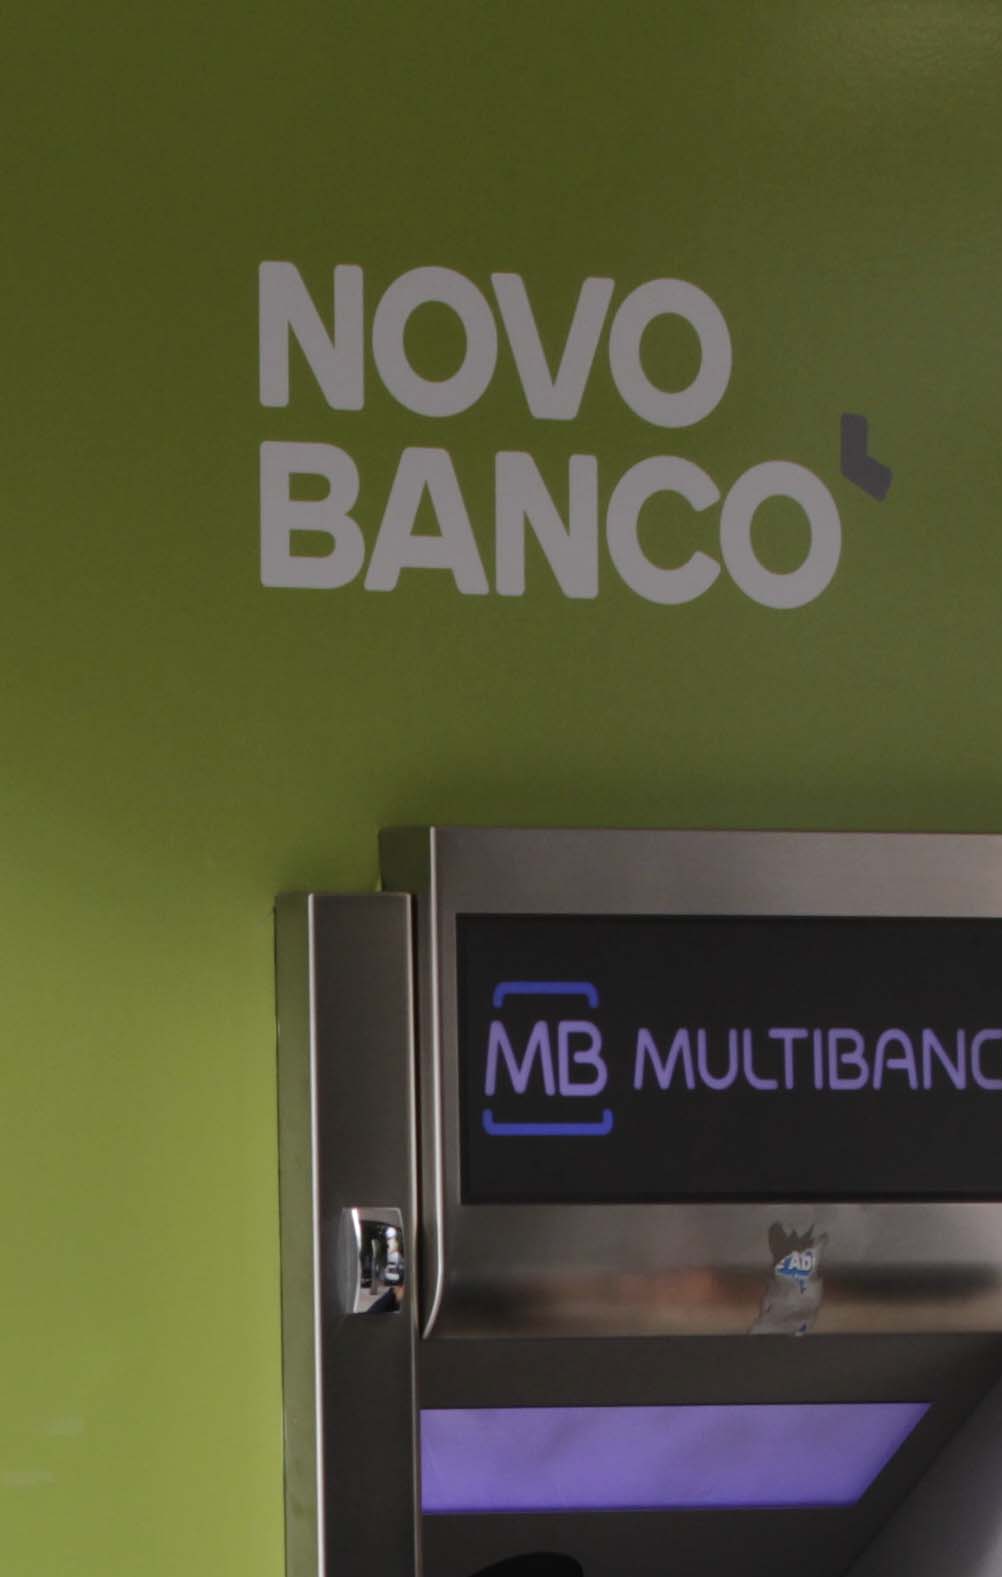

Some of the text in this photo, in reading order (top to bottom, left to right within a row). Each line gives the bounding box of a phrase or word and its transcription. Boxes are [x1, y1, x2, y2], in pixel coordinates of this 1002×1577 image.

[258, 260, 733, 429] NOVO
[259, 440, 842, 610] BANCO
[484, 1020, 608, 1096] MB
